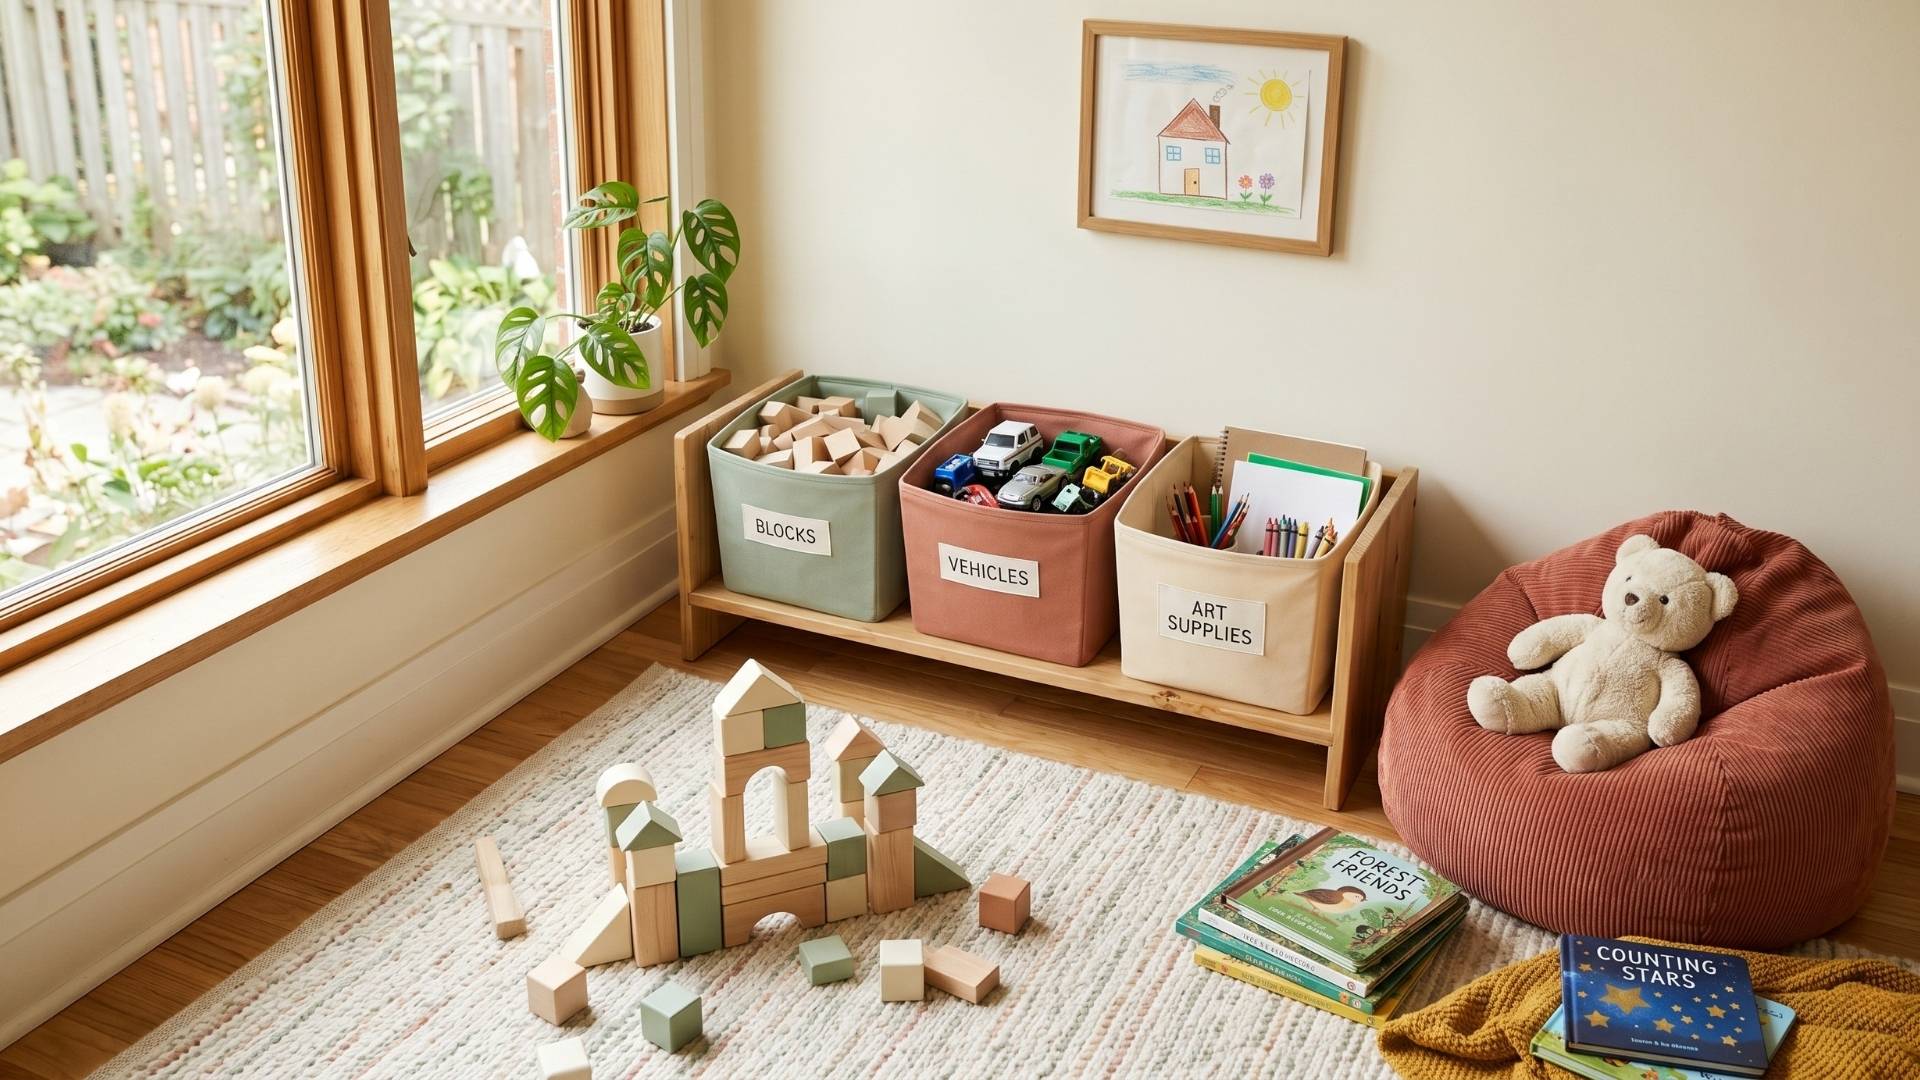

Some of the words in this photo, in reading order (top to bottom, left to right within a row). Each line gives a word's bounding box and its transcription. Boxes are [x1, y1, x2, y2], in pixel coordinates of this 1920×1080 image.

[755, 518, 816, 544] BLOCKS
[948, 555, 1029, 586] VEHICLES
[1192, 600, 1227, 621] ART
[1168, 614, 1252, 645] SUPPLIES
[1332, 859, 1411, 901] FRIENDS
[1349, 850, 1425, 886] FOREST
[1597, 946, 1717, 975] COUNTING
[1622, 966, 1696, 989] STARS
